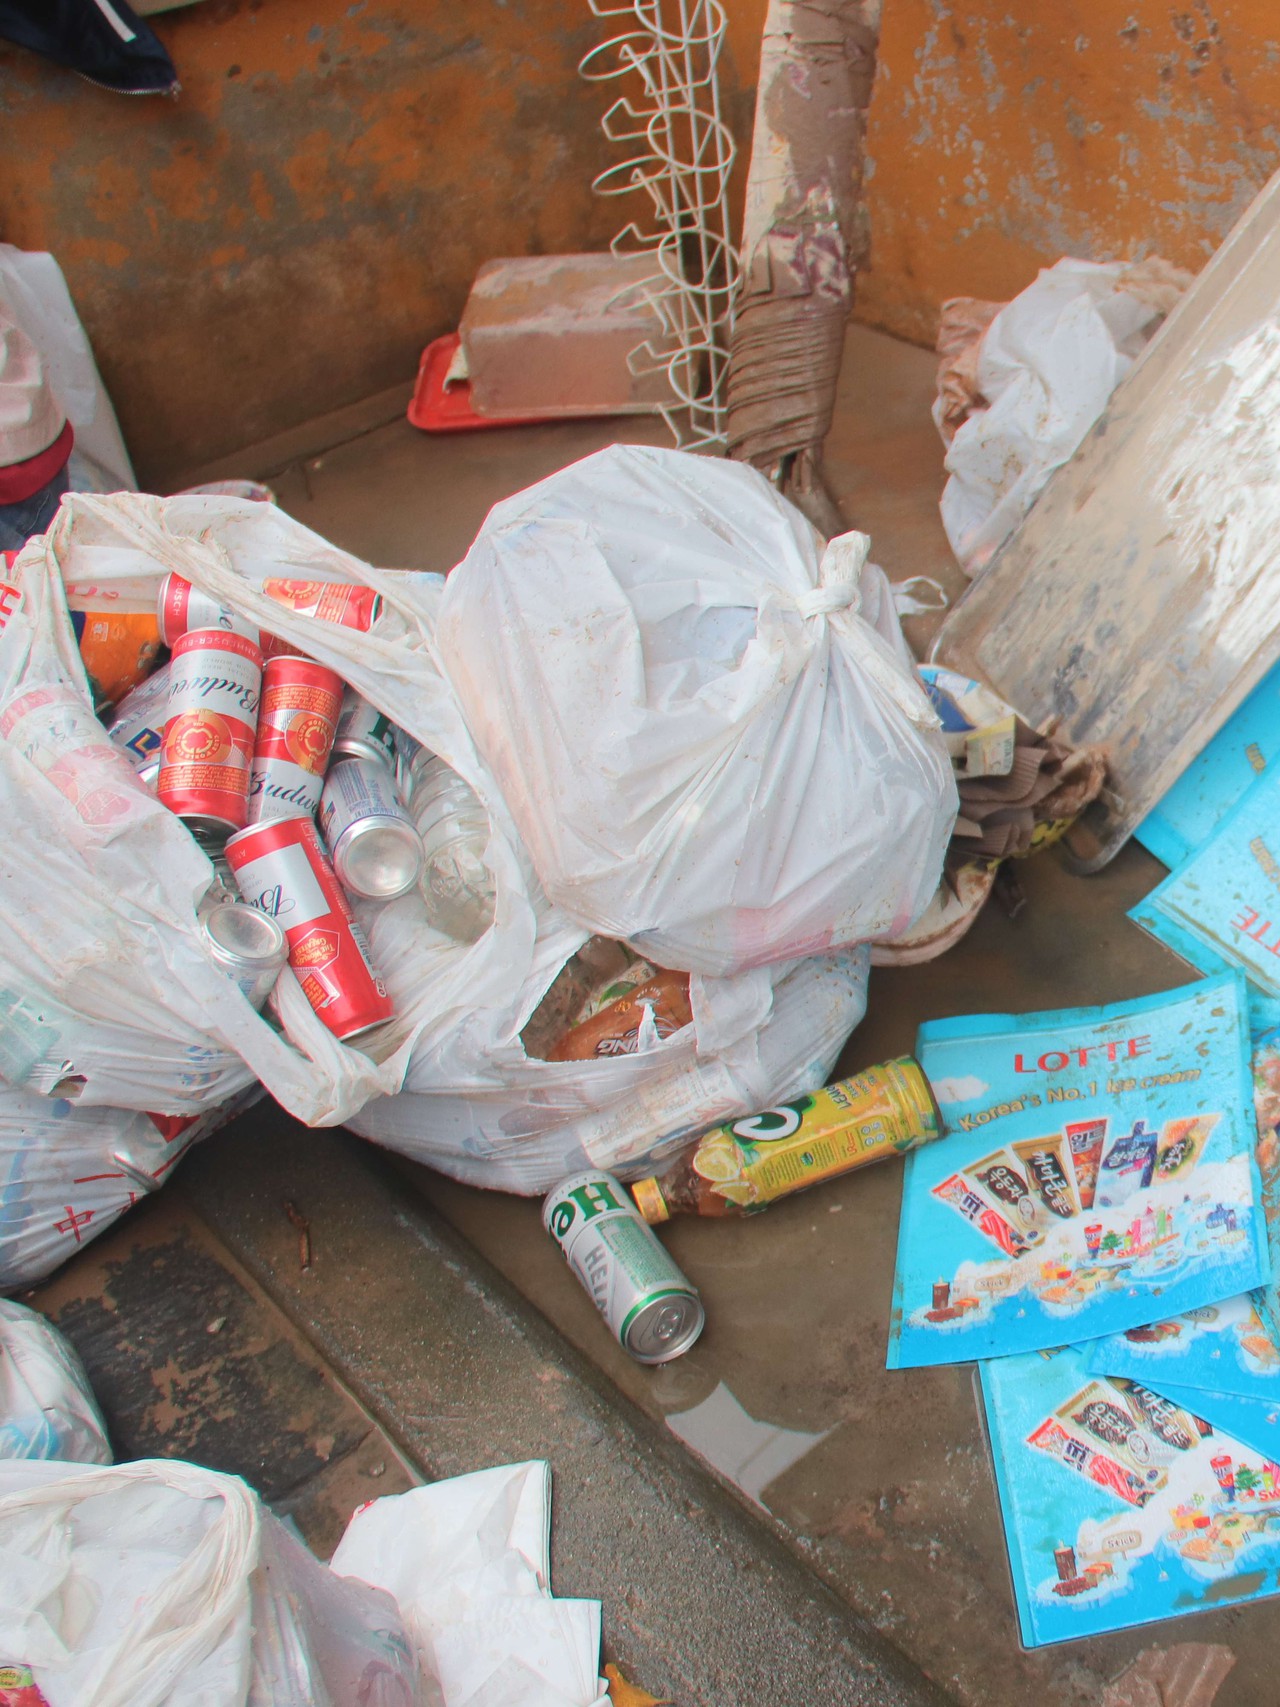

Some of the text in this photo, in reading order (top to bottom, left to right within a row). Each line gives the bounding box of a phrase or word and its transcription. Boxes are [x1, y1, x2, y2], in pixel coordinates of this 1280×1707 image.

[1013, 1034, 1152, 1074] LOTTE
[958, 1068, 1201, 1132] Korea's No.1 Ice cream
[990, 1167, 1024, 1199] 옥동자
[1086, 1402, 1131, 1437] 옥동자
[1106, 1534, 1137, 1549] Stick
